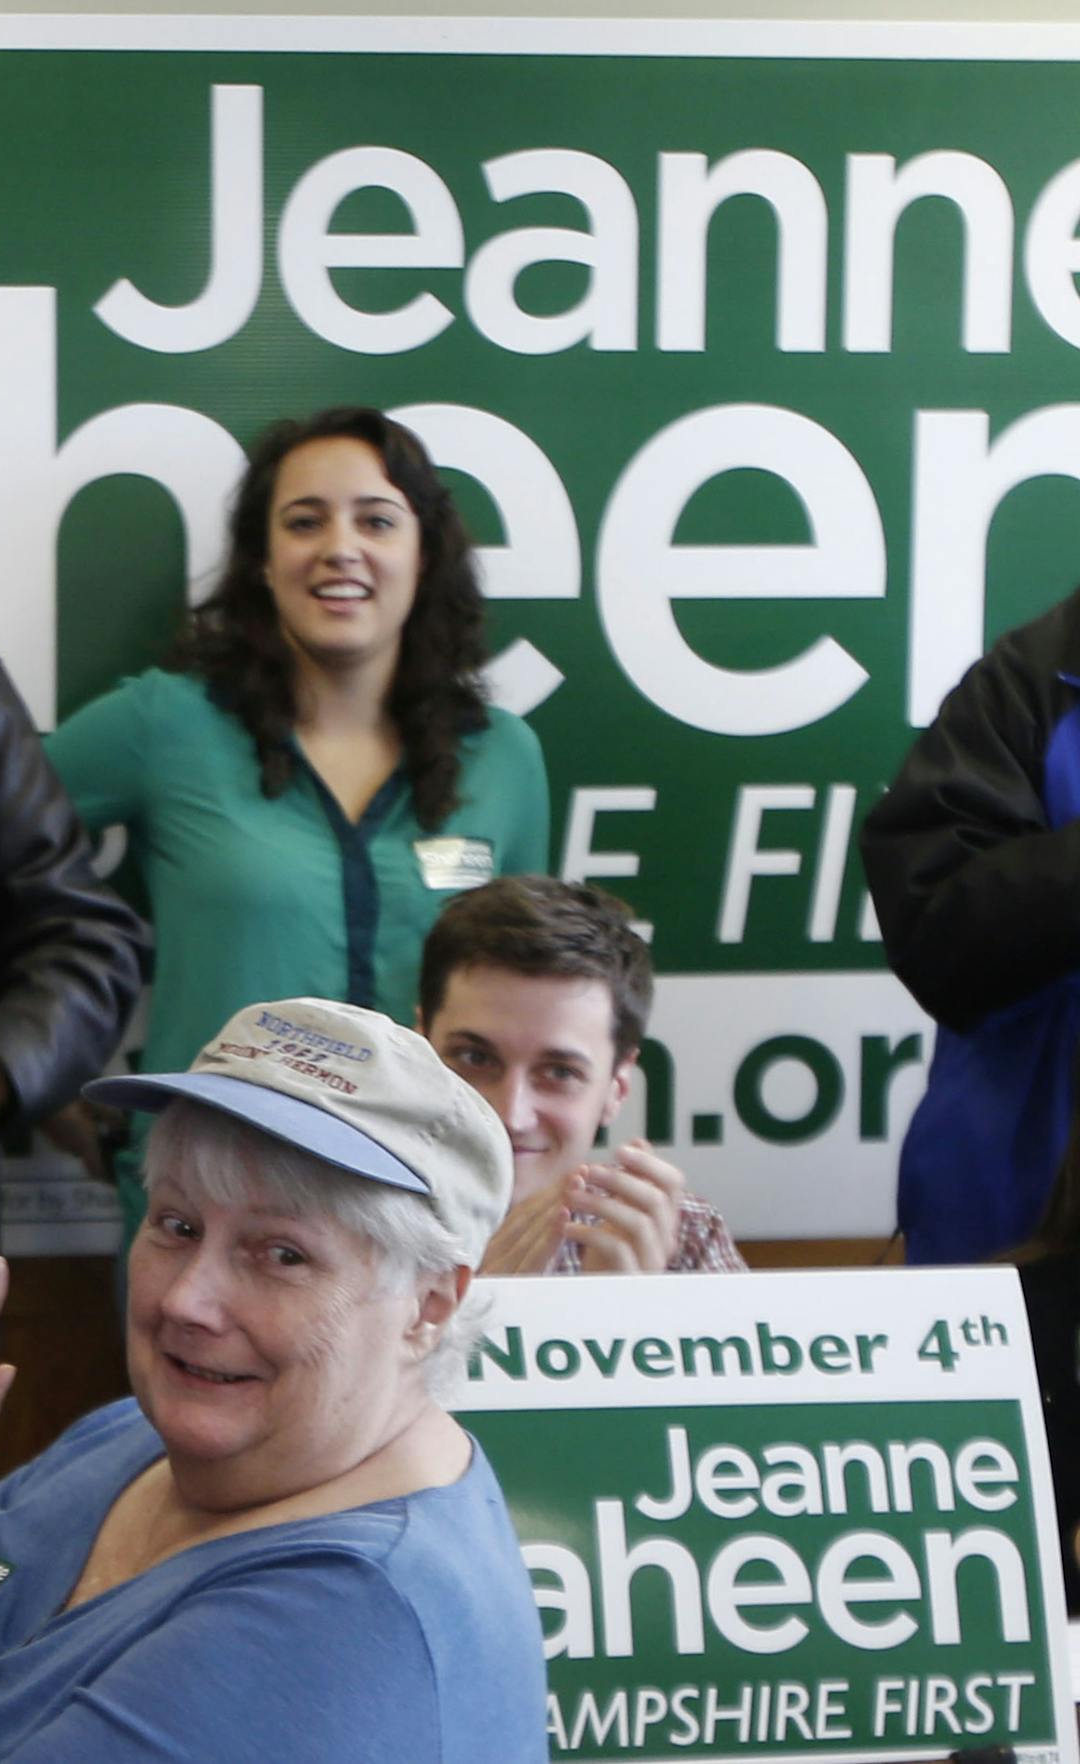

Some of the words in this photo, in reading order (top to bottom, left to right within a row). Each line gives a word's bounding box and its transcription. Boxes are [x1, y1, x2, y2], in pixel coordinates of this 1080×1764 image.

[716, 784, 883, 944] FI
[255, 1011, 372, 1062] NORTHFIELD
[278, 1056, 358, 1095] HERMON
[466, 1322, 888, 1381] November
[917, 1314, 1009, 1373] 4th
[635, 1427, 1019, 1520] Jeanne
[874, 1673, 1035, 1738] FIRST
